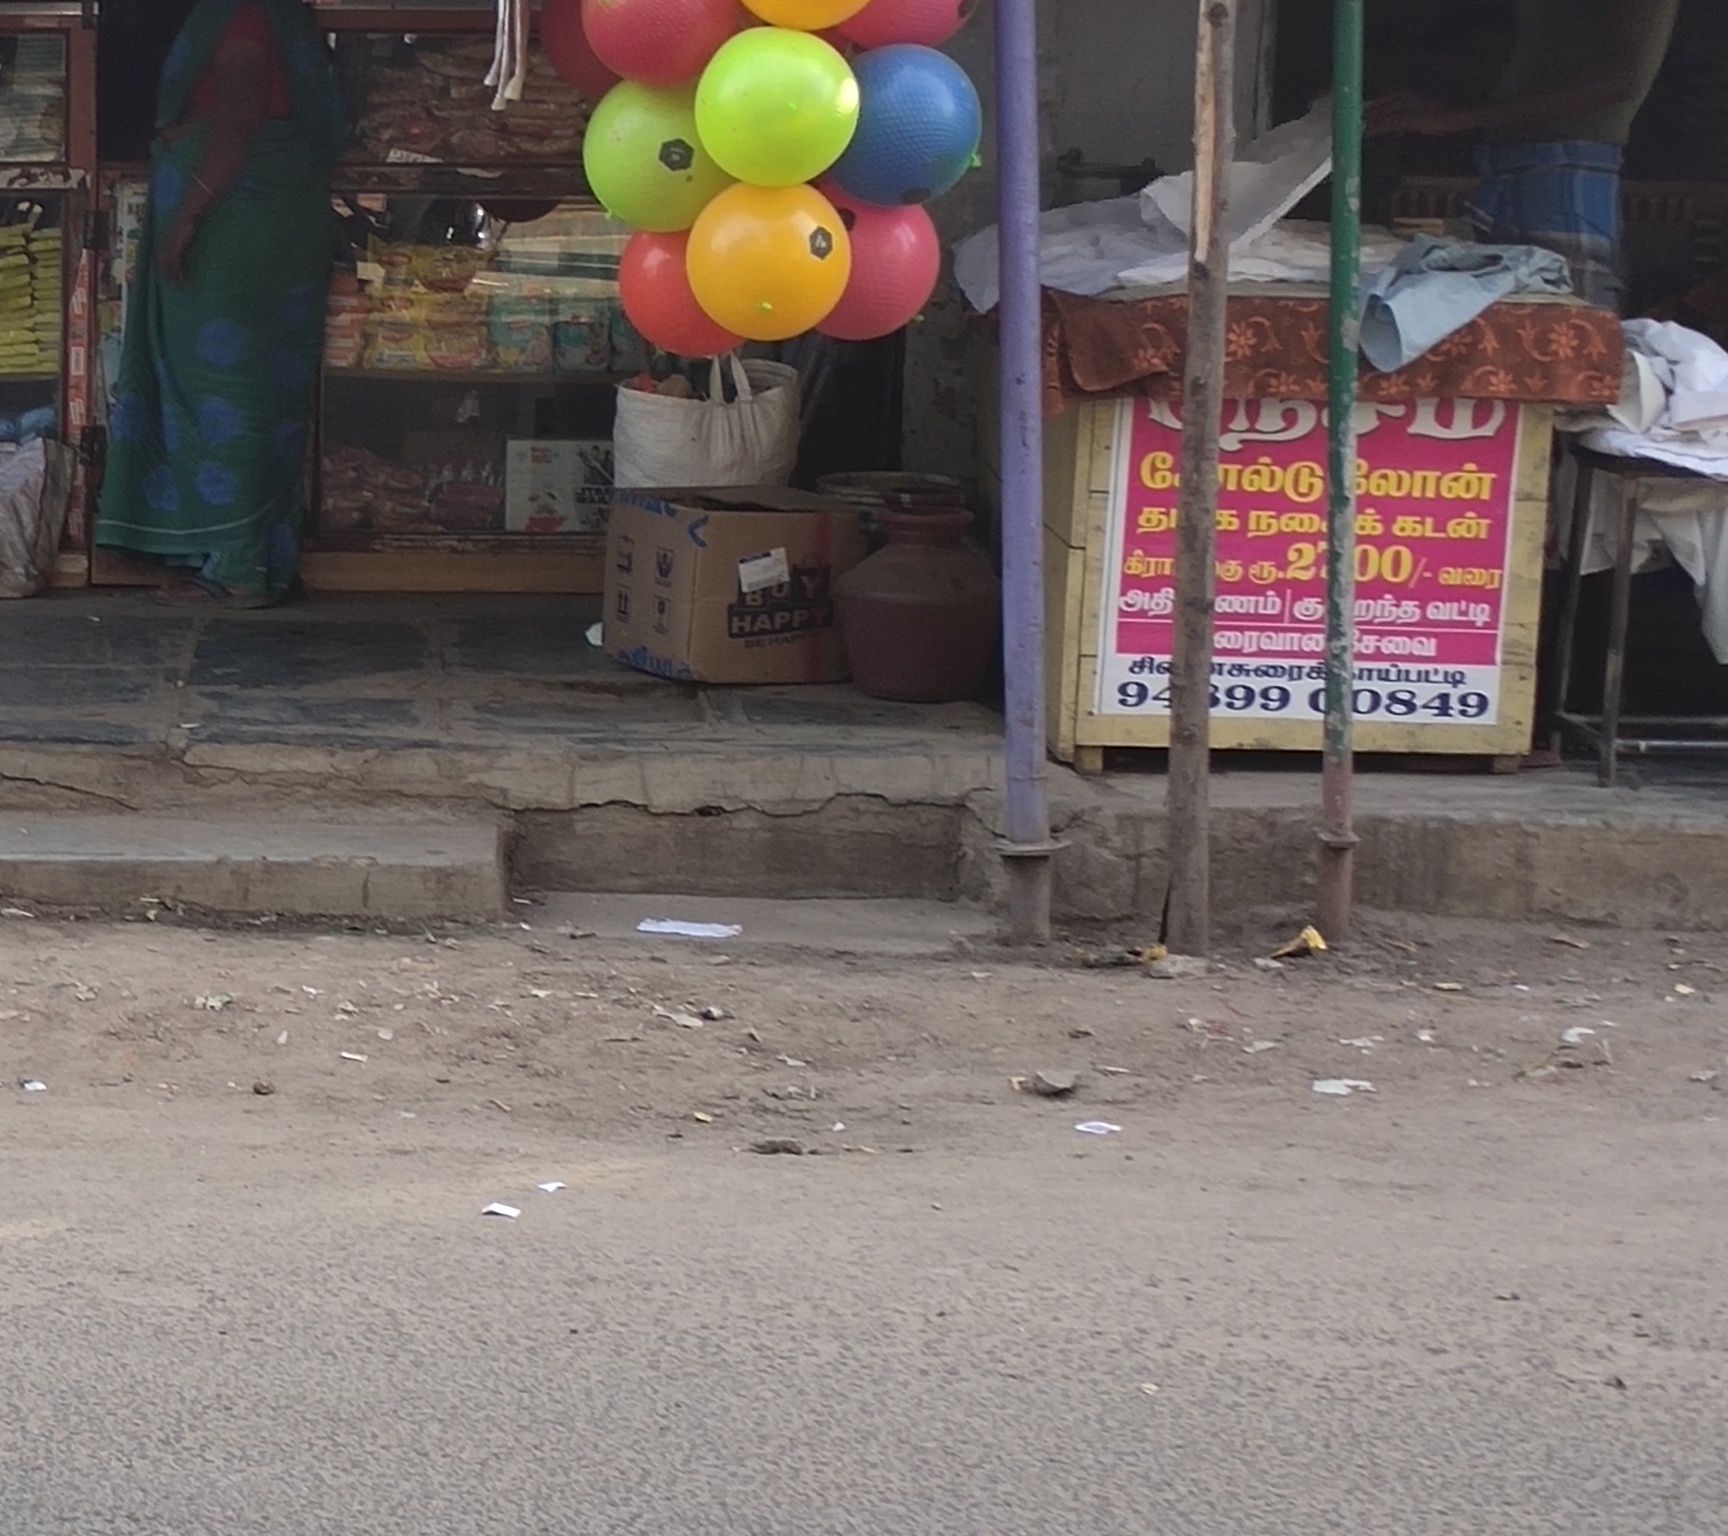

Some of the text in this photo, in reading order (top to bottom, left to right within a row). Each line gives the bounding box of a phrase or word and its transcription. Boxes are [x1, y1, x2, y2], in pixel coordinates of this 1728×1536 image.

[1391, 510, 1493, 540] கடன்
[1437, 565, 1503, 590] வரை
[1426, 598, 1492, 628] வட்டி
